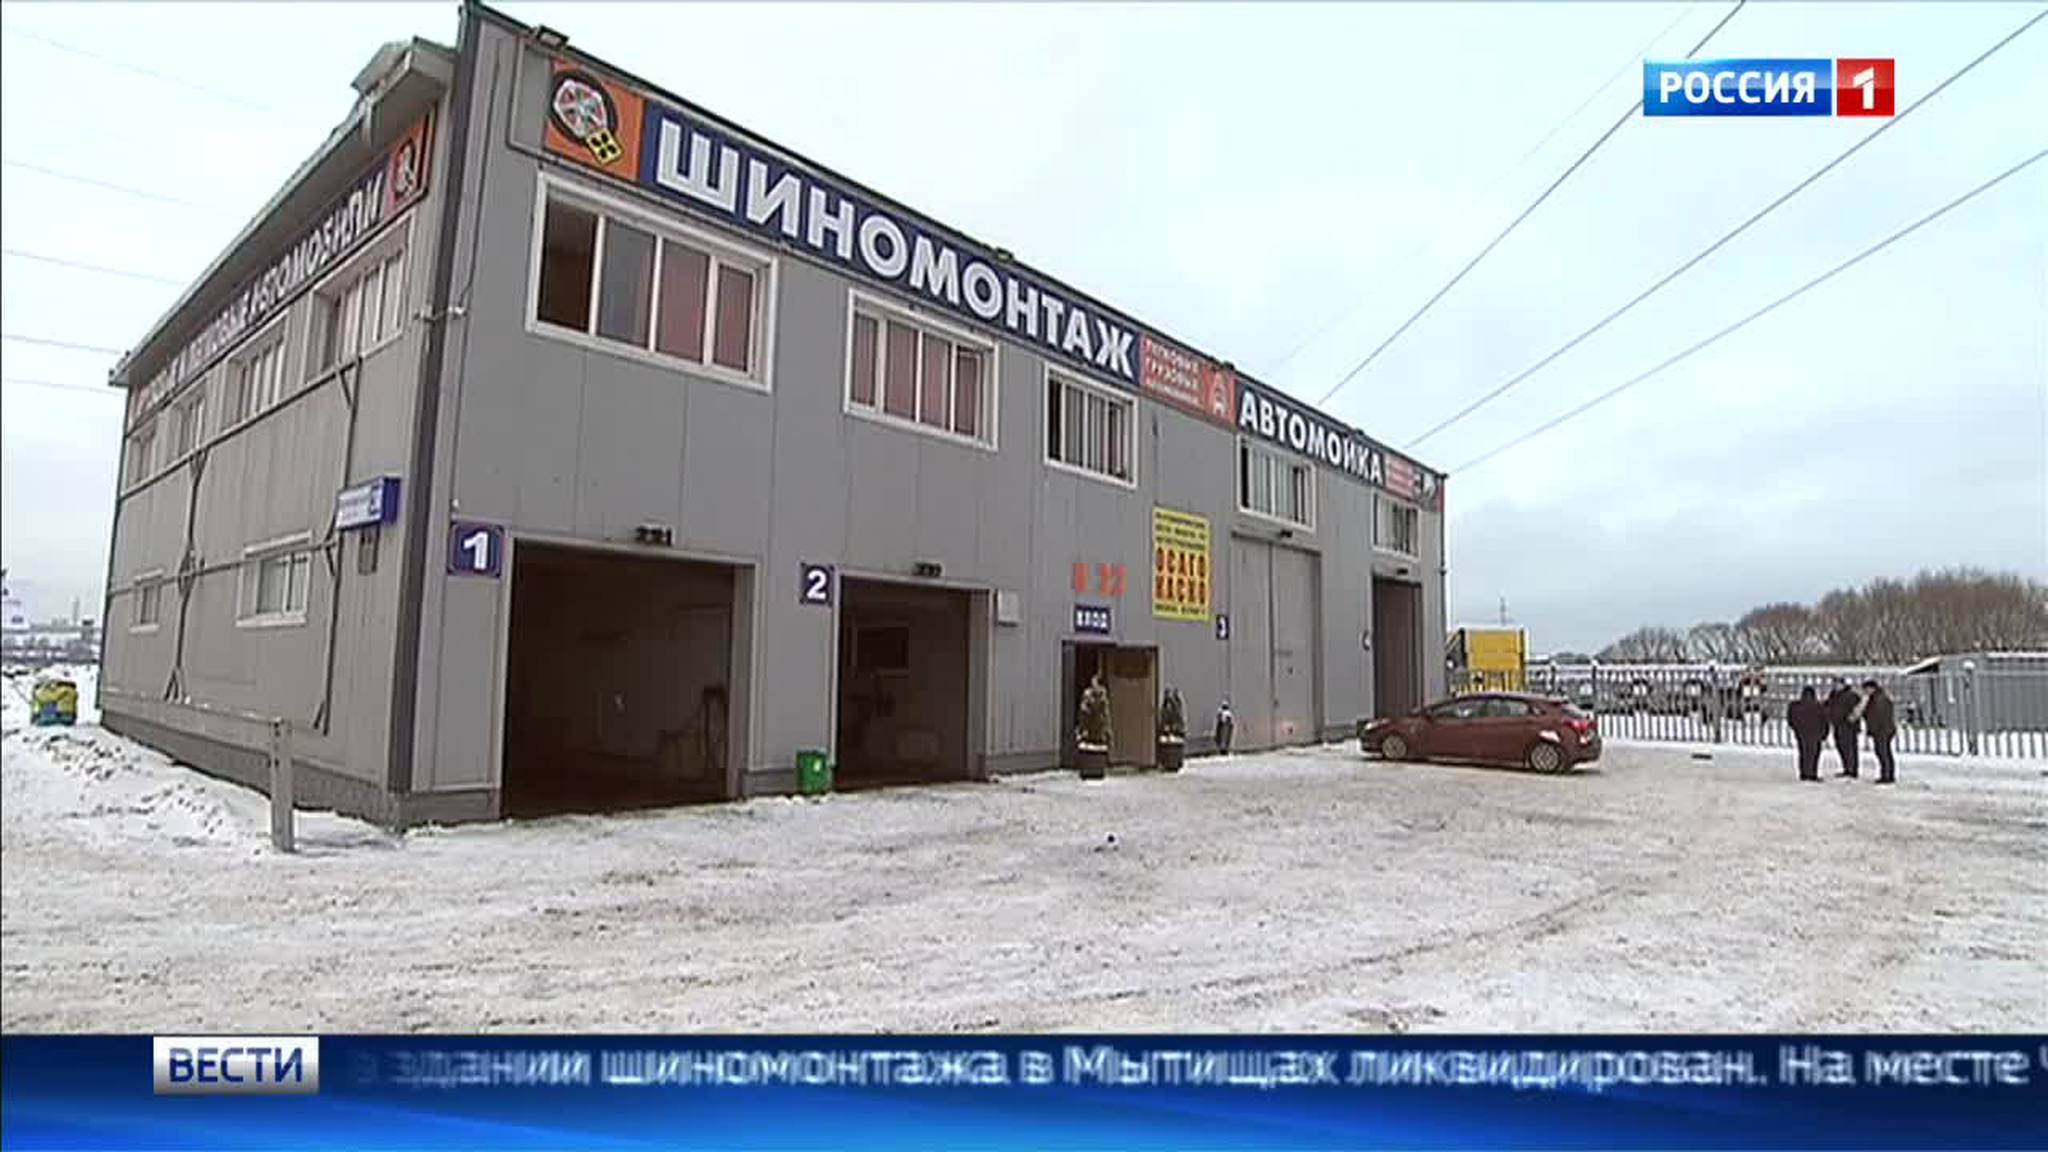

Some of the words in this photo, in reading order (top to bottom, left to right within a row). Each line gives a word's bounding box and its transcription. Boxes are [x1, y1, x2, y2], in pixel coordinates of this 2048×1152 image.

[655, 116, 1136, 378] ШИНОМОНТАЖ
[463, 531, 489, 570] 1
[806, 569, 828, 600] 2
